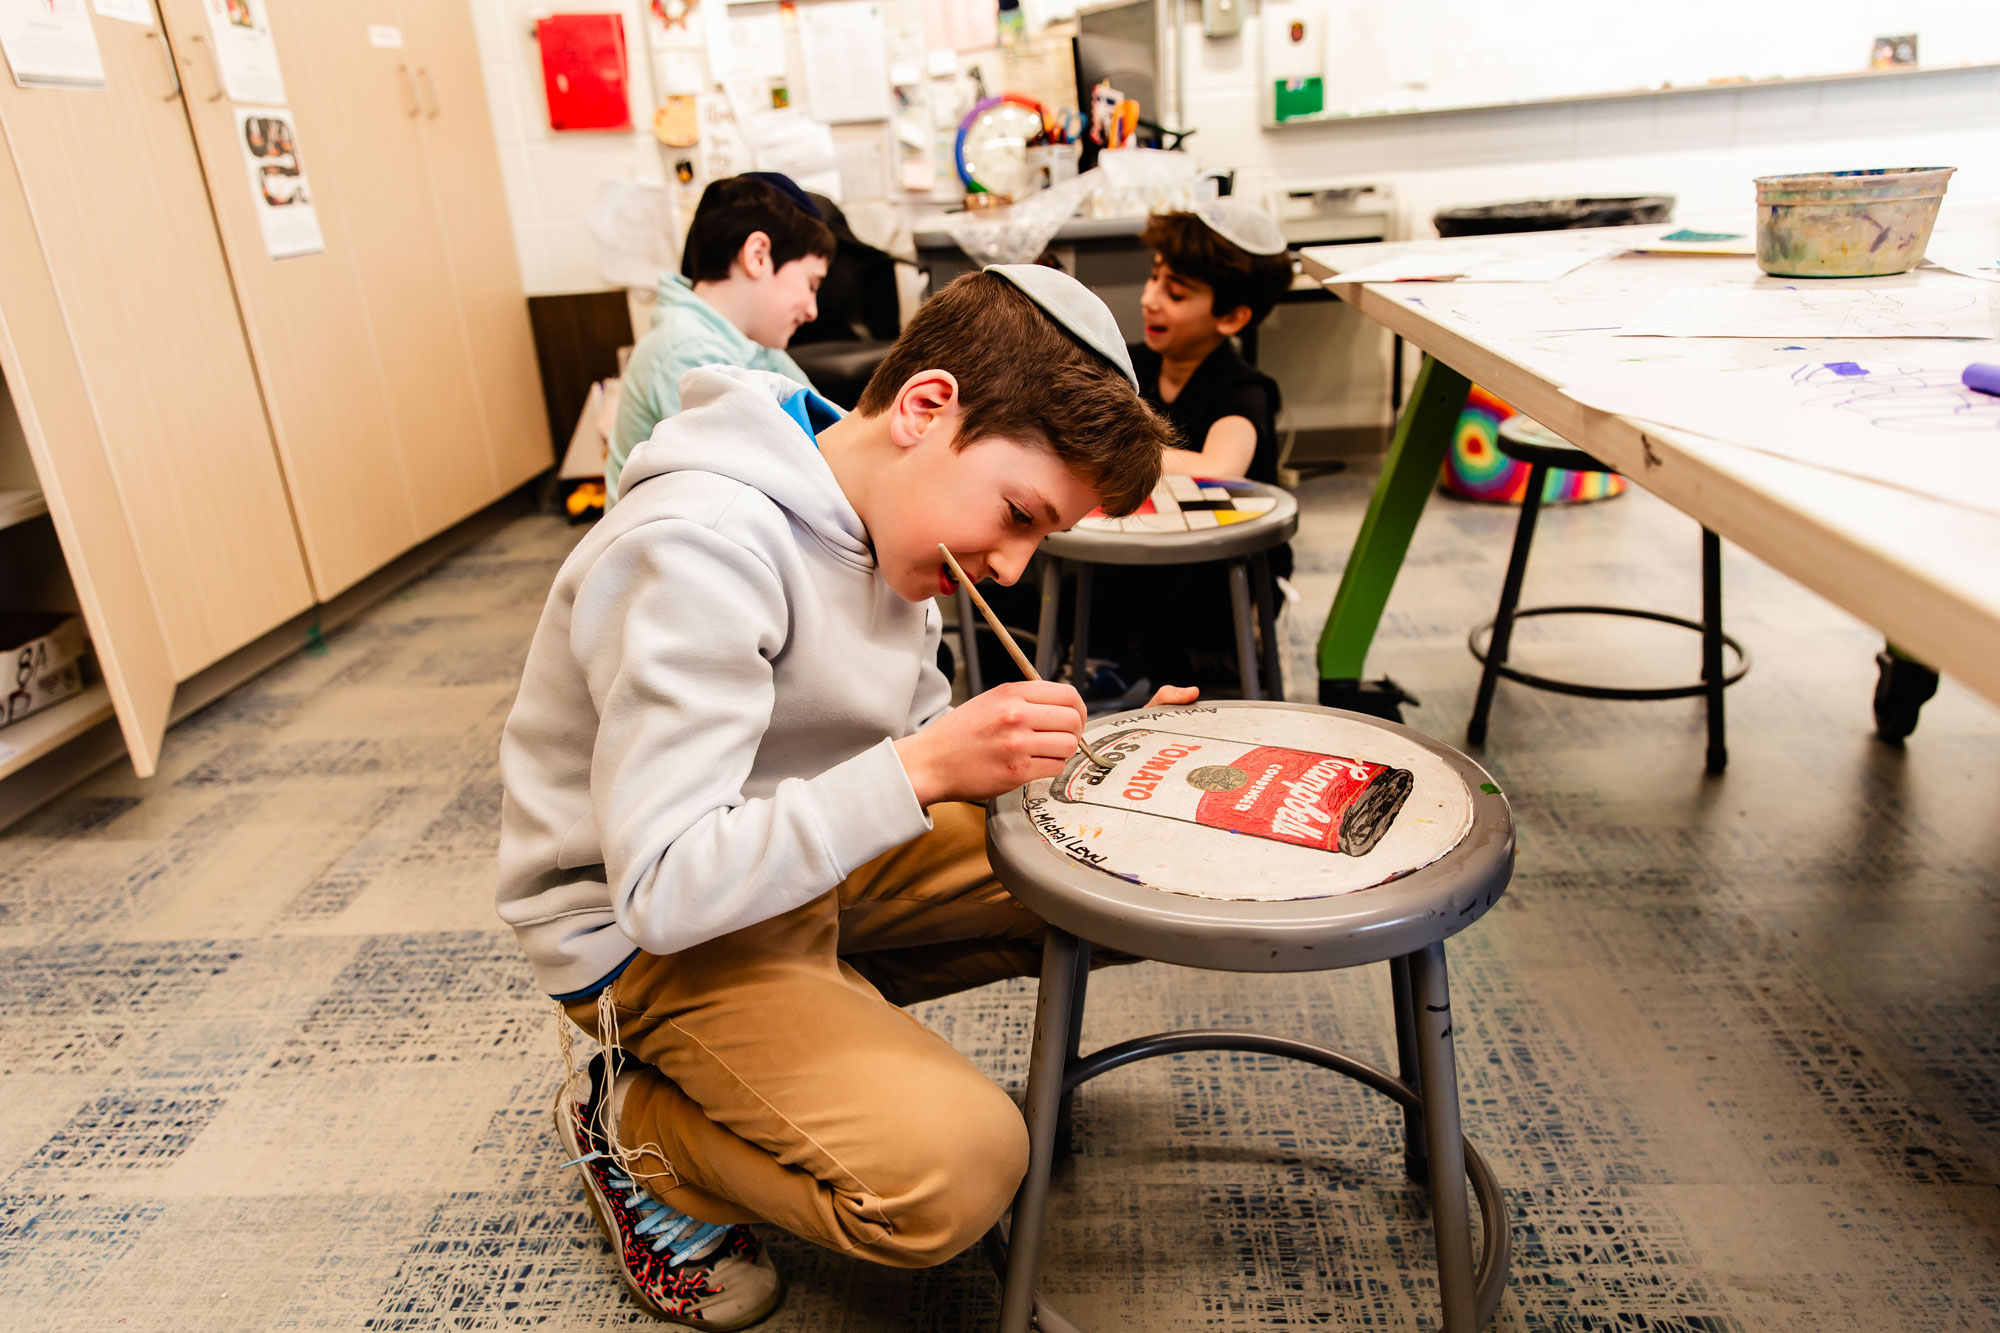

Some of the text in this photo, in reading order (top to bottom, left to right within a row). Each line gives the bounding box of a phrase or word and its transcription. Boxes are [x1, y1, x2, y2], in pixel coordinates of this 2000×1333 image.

[1174, 706, 1218, 716] Andy
[1079, 742, 1140, 786] SOUP
[1122, 743, 1203, 801] TOMATO
[1232, 763, 1284, 812] CONDENSED
